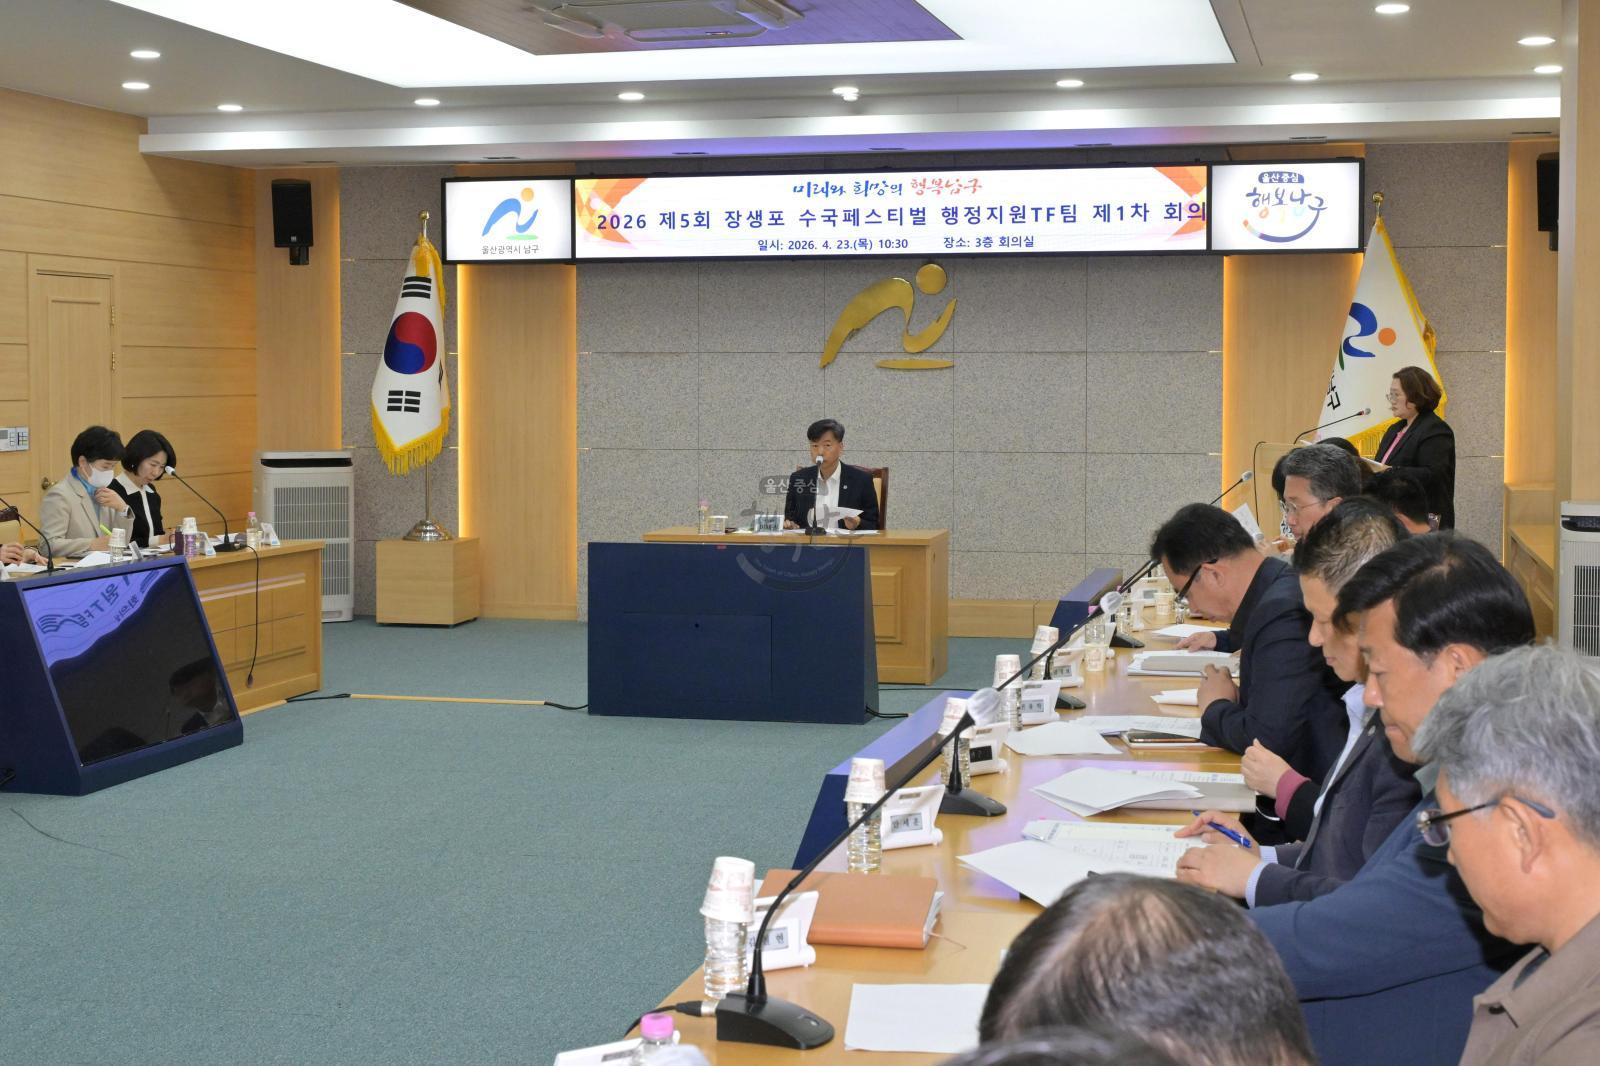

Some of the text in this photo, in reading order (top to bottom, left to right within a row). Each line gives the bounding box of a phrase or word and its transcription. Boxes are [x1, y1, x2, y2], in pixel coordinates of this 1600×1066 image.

[1261, 172, 1299, 183] 울산중심
[792, 177, 983, 198] 미래와 희망의 행복남구
[597, 201, 1206, 230] 2026 제5회 장생포 수국페스티벌 행정지원TF팀 제1차 회의
[757, 238, 909, 251] 일시: 2026. 4. 23.(목) 10:30
[943, 235, 1035, 249] 장소: 3층 회의실
[481, 244, 540, 255] 울산광역시 남구
